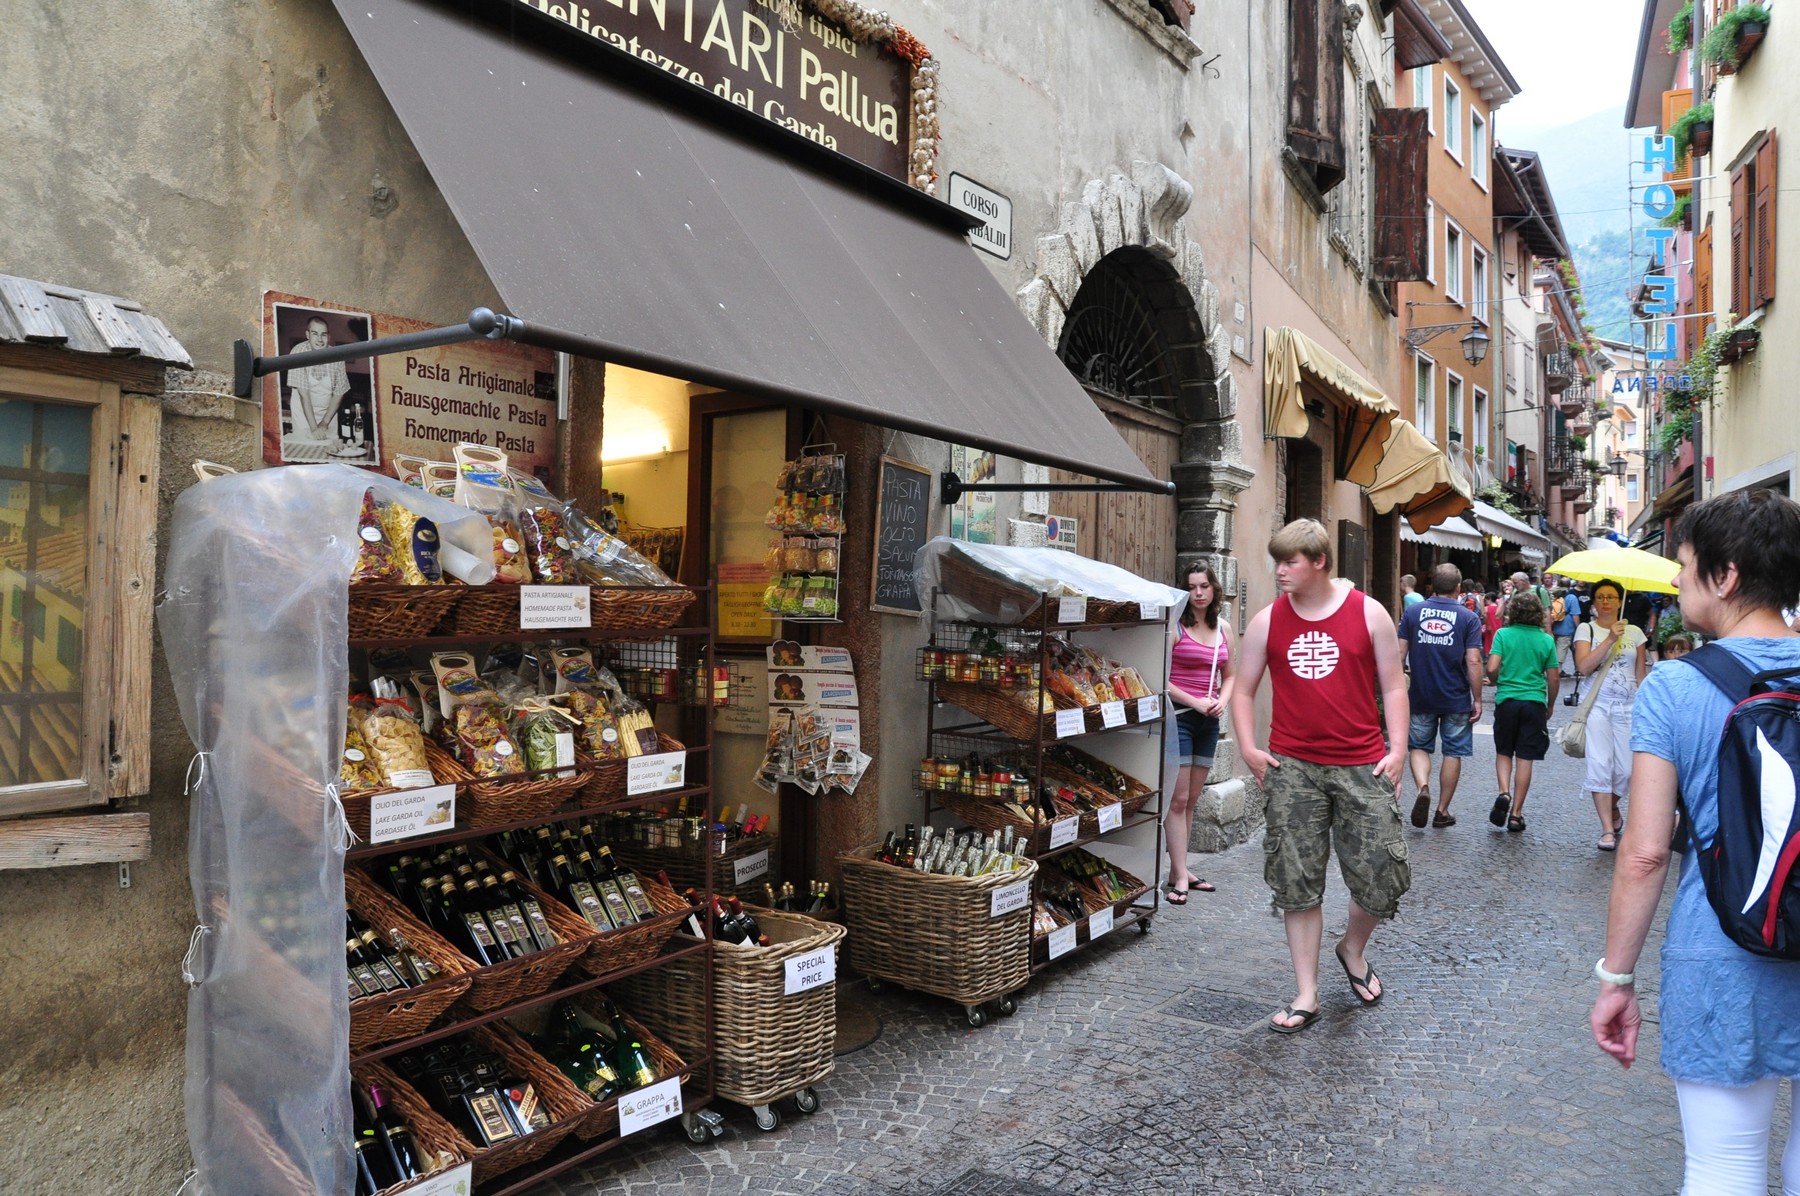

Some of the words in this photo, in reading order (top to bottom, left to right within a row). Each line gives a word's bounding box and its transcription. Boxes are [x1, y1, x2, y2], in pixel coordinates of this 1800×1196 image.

[809, 15, 857, 57] tipici
[800, 47, 898, 145] Pallua
[713, 76, 754, 112] del
[763, 99, 838, 151] Garda
[963, 190, 999, 219] CORSO
[405, 356, 450, 383] Pasta
[458, 365, 535, 397] Artigianale
[391, 384, 501, 420] Hausgemachte
[508, 403, 547, 427] Pasta
[404, 417, 488, 445] Homemade
[495, 430, 535, 453] Pasta
[885, 466, 921, 500] PASTA
[884, 499, 917, 524] VINO
[882, 526, 916, 543] OLIO
[1419, 607, 1458, 625] EASTERN
[1418, 629, 1455, 646] SUBURBS
[375, 801, 391, 809] OLIO
[391, 799, 402, 807] DEL
[404, 796, 426, 805] GARDA
[375, 816, 390, 825] LAKE
[391, 812, 413, 821] GARDA
[375, 826, 407, 837] GARDASEE
[408, 823, 416, 831] ÖL
[737, 858, 767, 877] PROSECCO
[995, 885, 1026, 901] LIMONCELLO
[996, 902, 1006, 911] DEL
[1006, 896, 1023, 908] GARDA
[797, 955, 826, 972] SPECIAL
[801, 971, 822, 986] PRICE
[636, 1093, 665, 1110] GRAPPA
